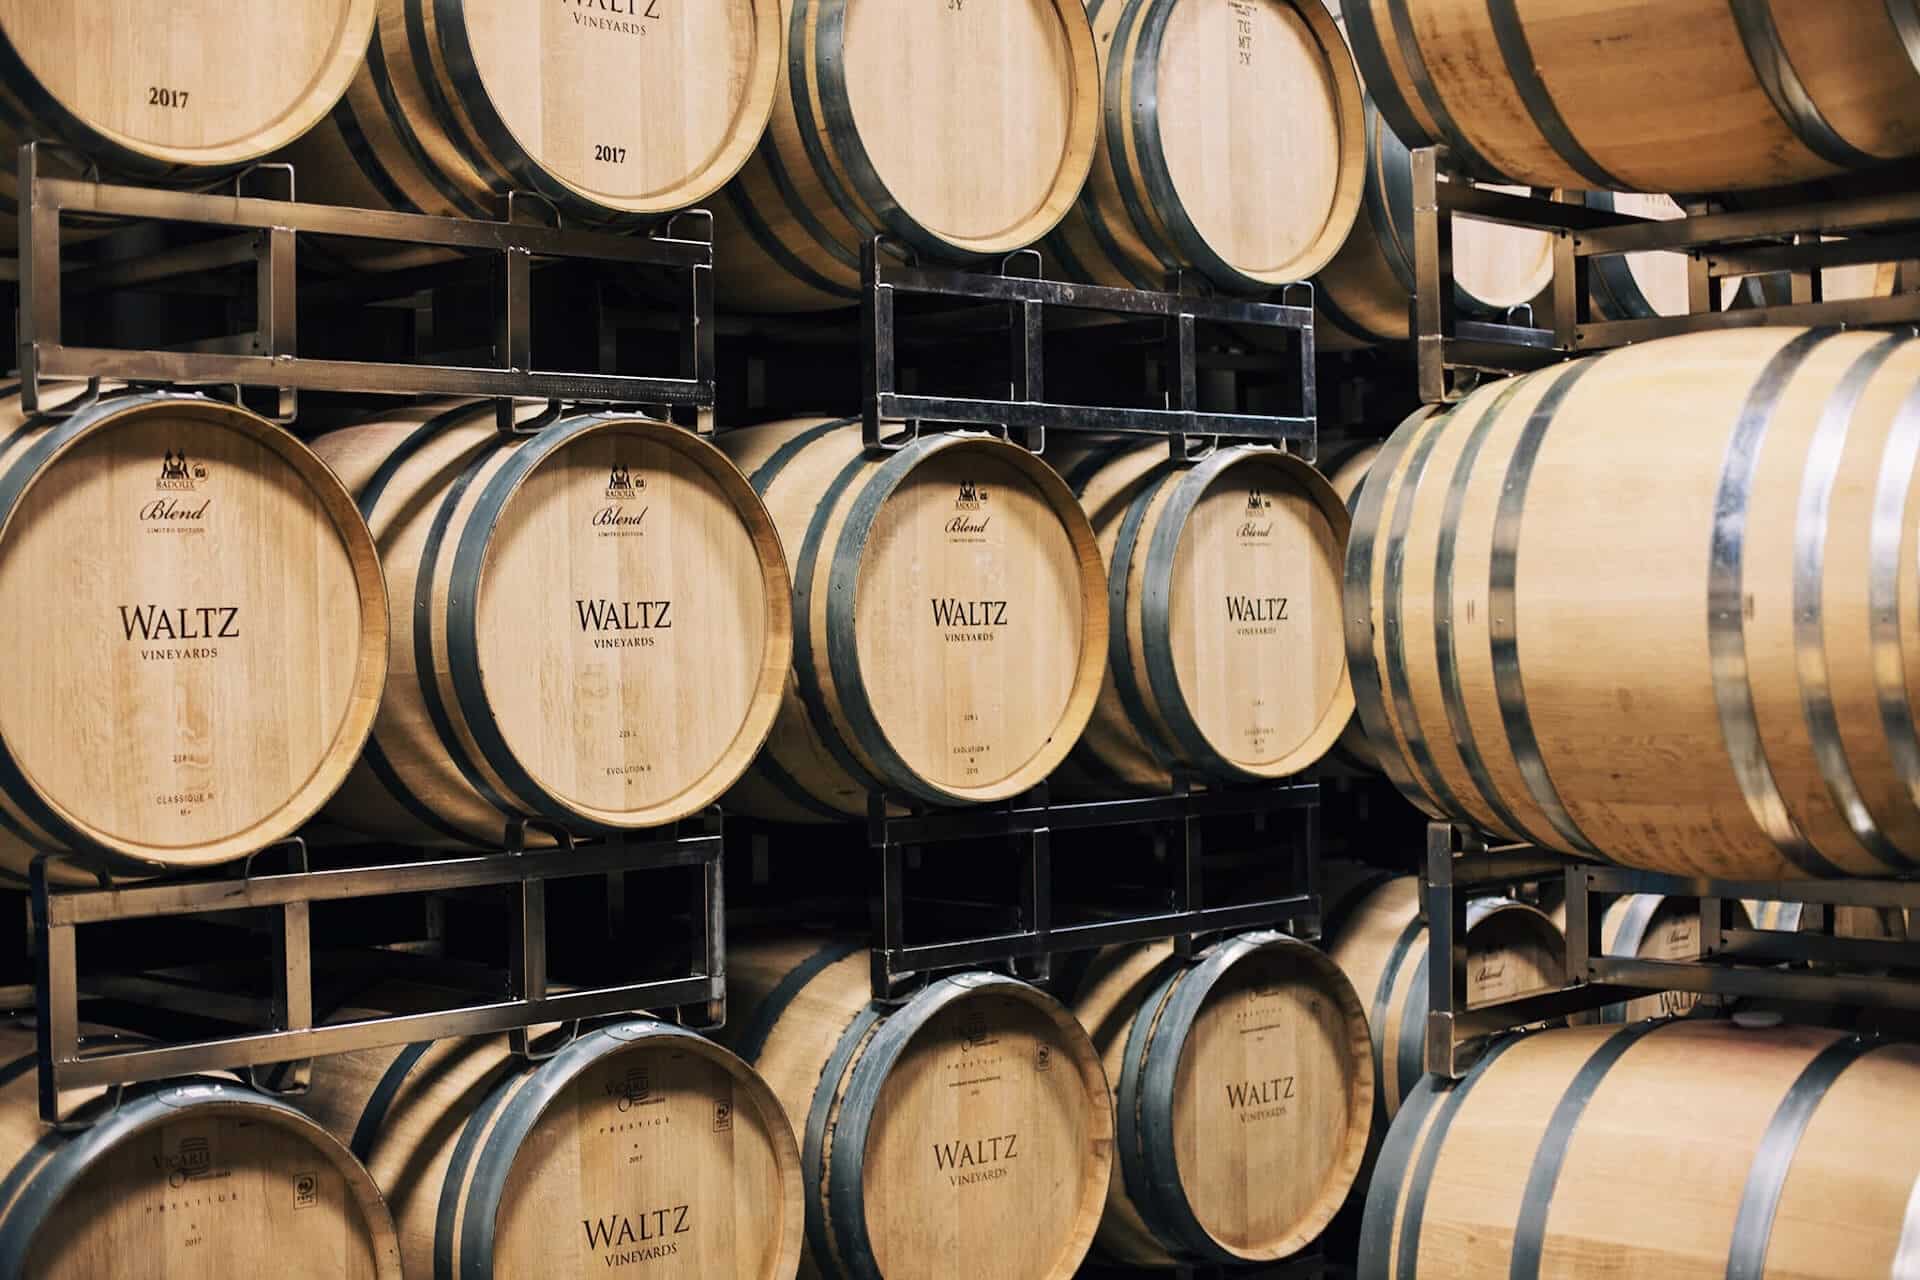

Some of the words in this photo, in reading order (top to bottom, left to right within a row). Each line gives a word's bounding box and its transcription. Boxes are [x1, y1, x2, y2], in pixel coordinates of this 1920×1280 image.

[573, 11, 647, 36] VINEYARDS
[149, 86, 189, 109] 2017
[595, 145, 626, 164] 2017
[140, 499, 211, 521] Blend
[592, 506, 649, 526] Blend
[944, 516, 991, 533] Blend
[576, 599, 672, 631] WALTZ
[930, 598, 1008, 627] WALTZ
[1226, 595, 1288, 622] WALTZ
[118, 604, 240, 640] WALTZ
[594, 636, 655, 648] VINEYARDS
[944, 632, 994, 642] VINEYARDS
[141, 648, 218, 660] VINEYARDS
[156, 793, 203, 805] CLASSIQUE
[1226, 1076, 1294, 1109] WALTZ
[933, 1134, 1018, 1171] WALTZ
[949, 1168, 1008, 1187] VINEYARDS
[582, 1205, 690, 1251] WALTZ
[605, 1242, 679, 1267] VINEYARDS
